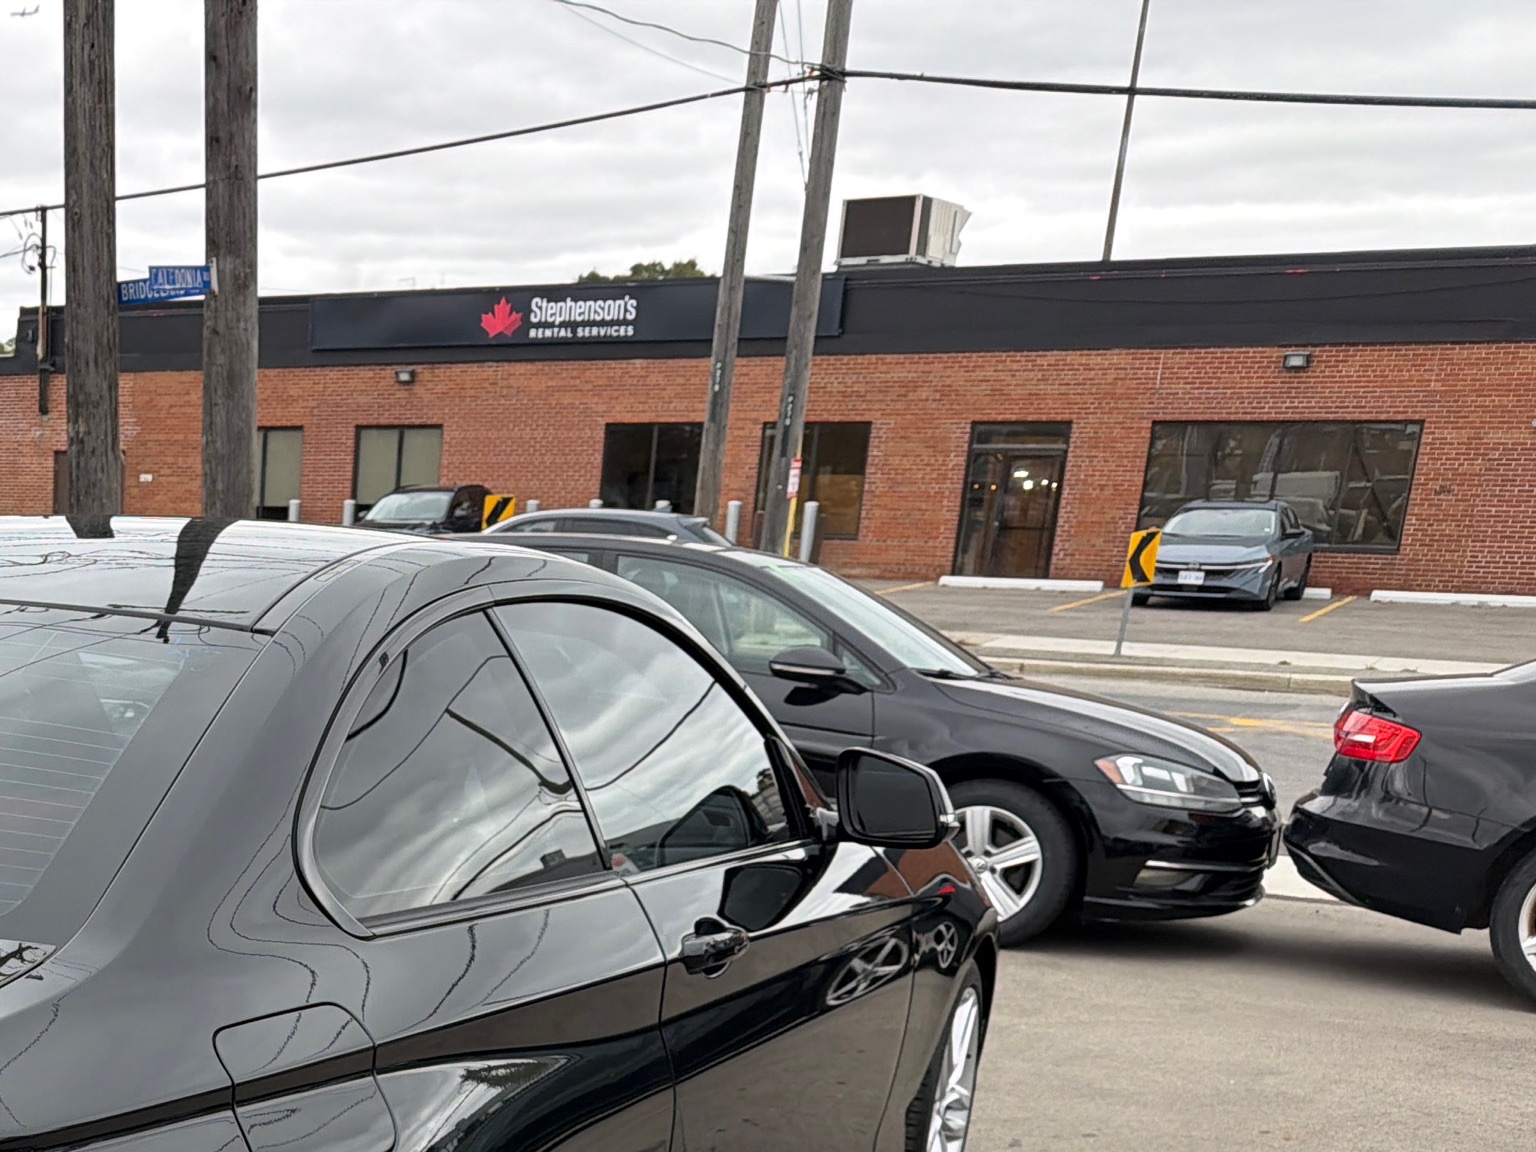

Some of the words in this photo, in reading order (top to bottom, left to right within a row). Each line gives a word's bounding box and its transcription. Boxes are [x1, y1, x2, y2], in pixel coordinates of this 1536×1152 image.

[151, 268, 204, 289] CALEDONIA
[530, 294, 637, 326] Stephenson's
[529, 327, 573, 339] RENTAL
[576, 325, 635, 338] SERVICES
